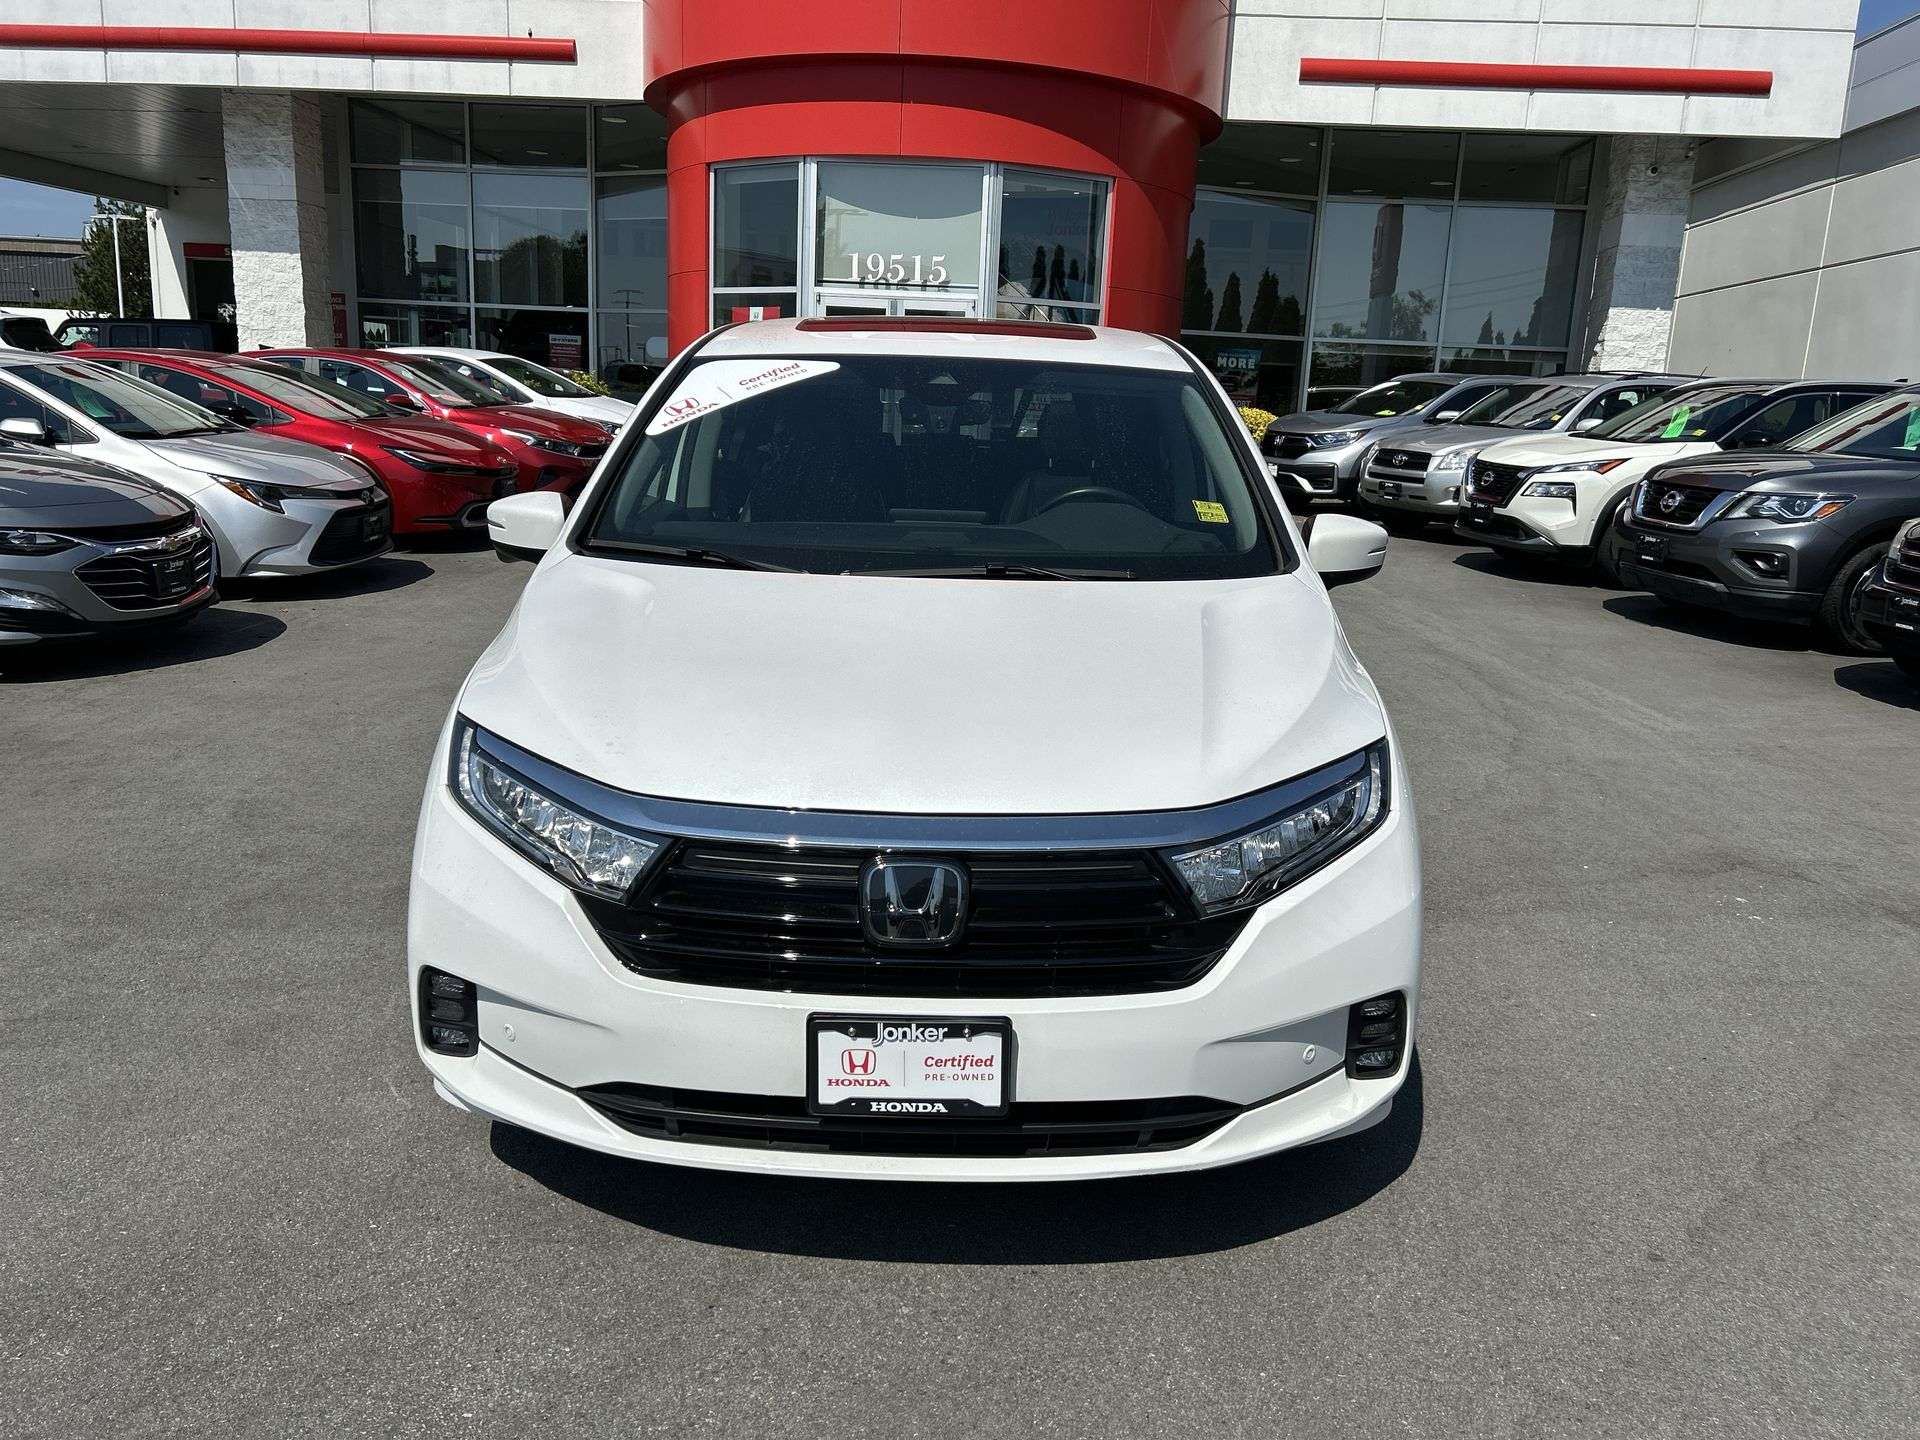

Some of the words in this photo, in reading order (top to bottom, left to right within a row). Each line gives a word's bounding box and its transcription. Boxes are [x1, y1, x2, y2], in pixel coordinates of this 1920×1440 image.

[847, 251, 947, 284] 19515
[1217, 356, 1256, 369] MORE
[738, 362, 801, 387] Certified
[745, 368, 808, 391] PRE-OWNED
[661, 402, 719, 427] HONDA
[872, 1022, 949, 1046] Jonker
[924, 1055, 995, 1071] Certified
[826, 1078, 891, 1087] HONDA
[924, 1073, 995, 1082] PRE-OWNED
[870, 1101, 949, 1113] HONDA
